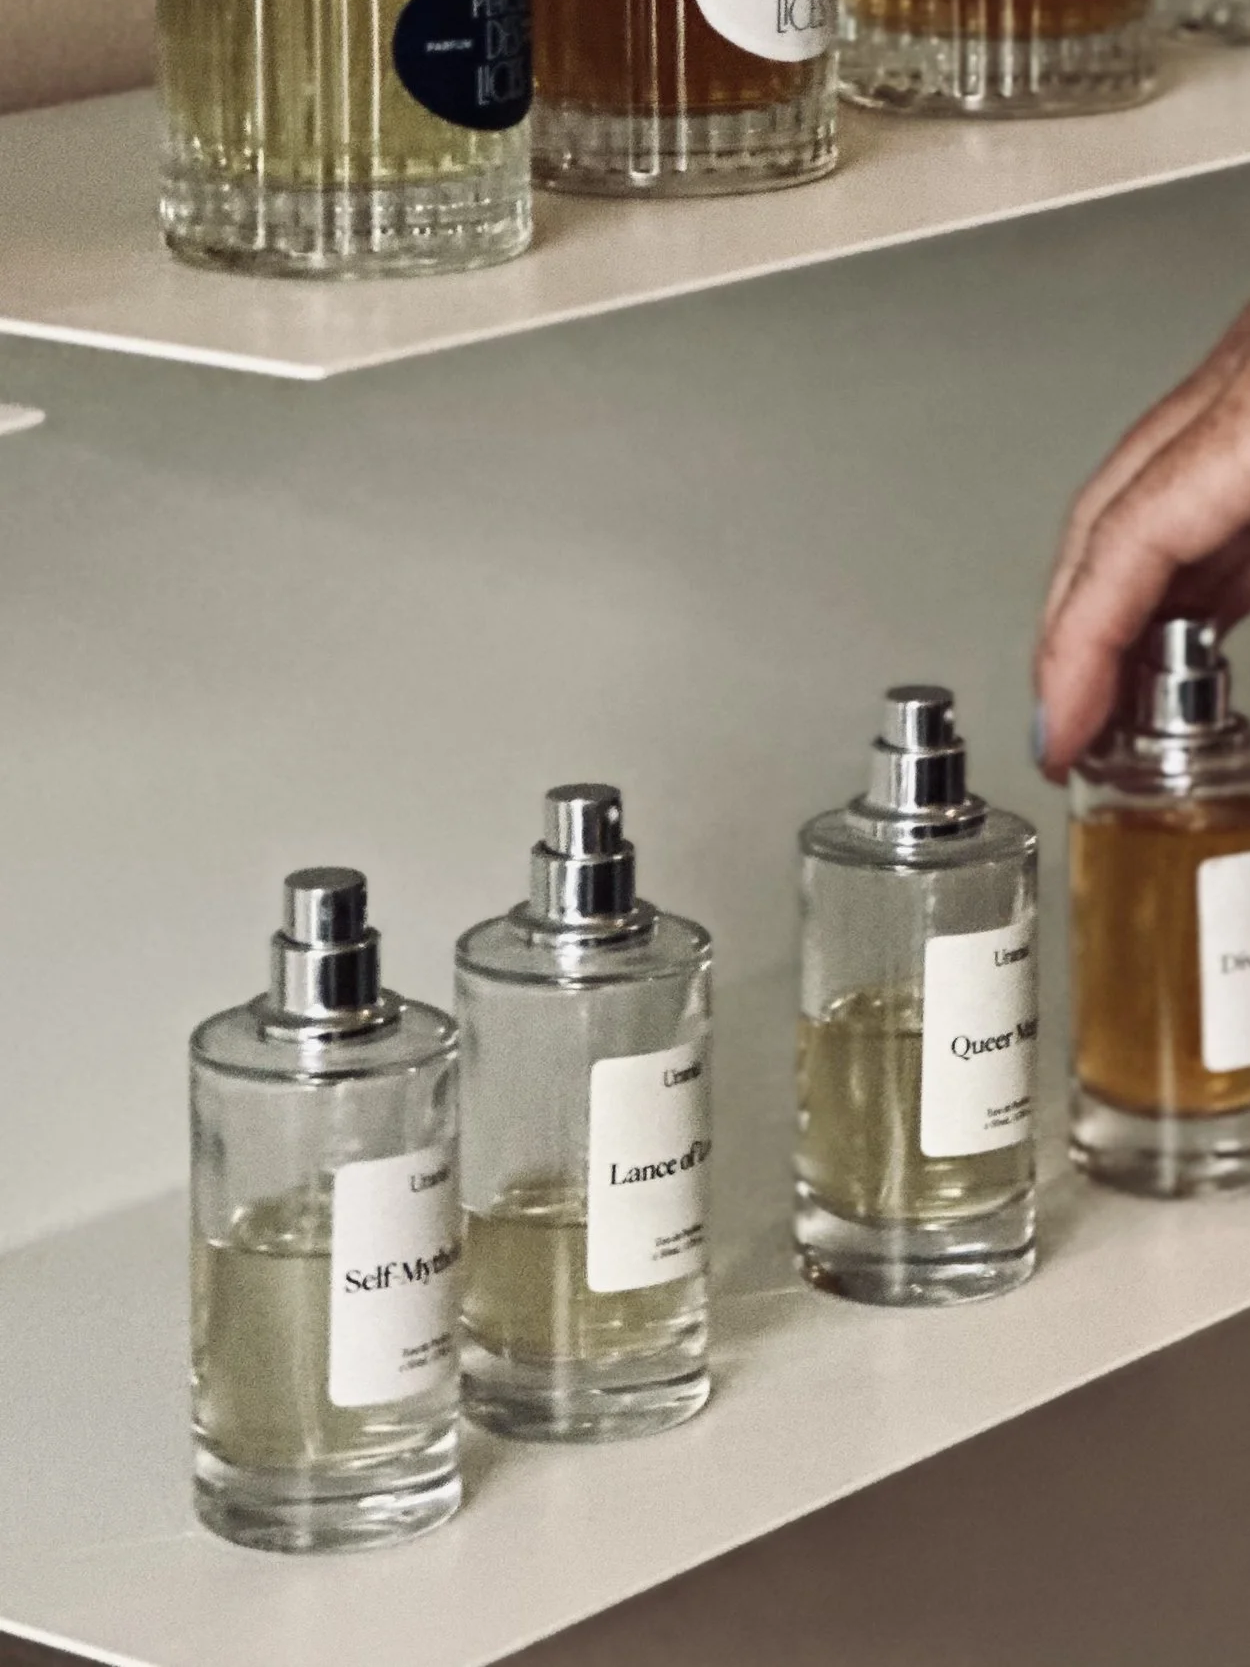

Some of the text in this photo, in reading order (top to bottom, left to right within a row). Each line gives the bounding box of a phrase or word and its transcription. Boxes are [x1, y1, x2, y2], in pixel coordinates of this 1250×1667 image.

[425, 39, 472, 52] PARFUM
[951, 1030, 1014, 1061] Queer
[608, 1162, 678, 1186] Lance
